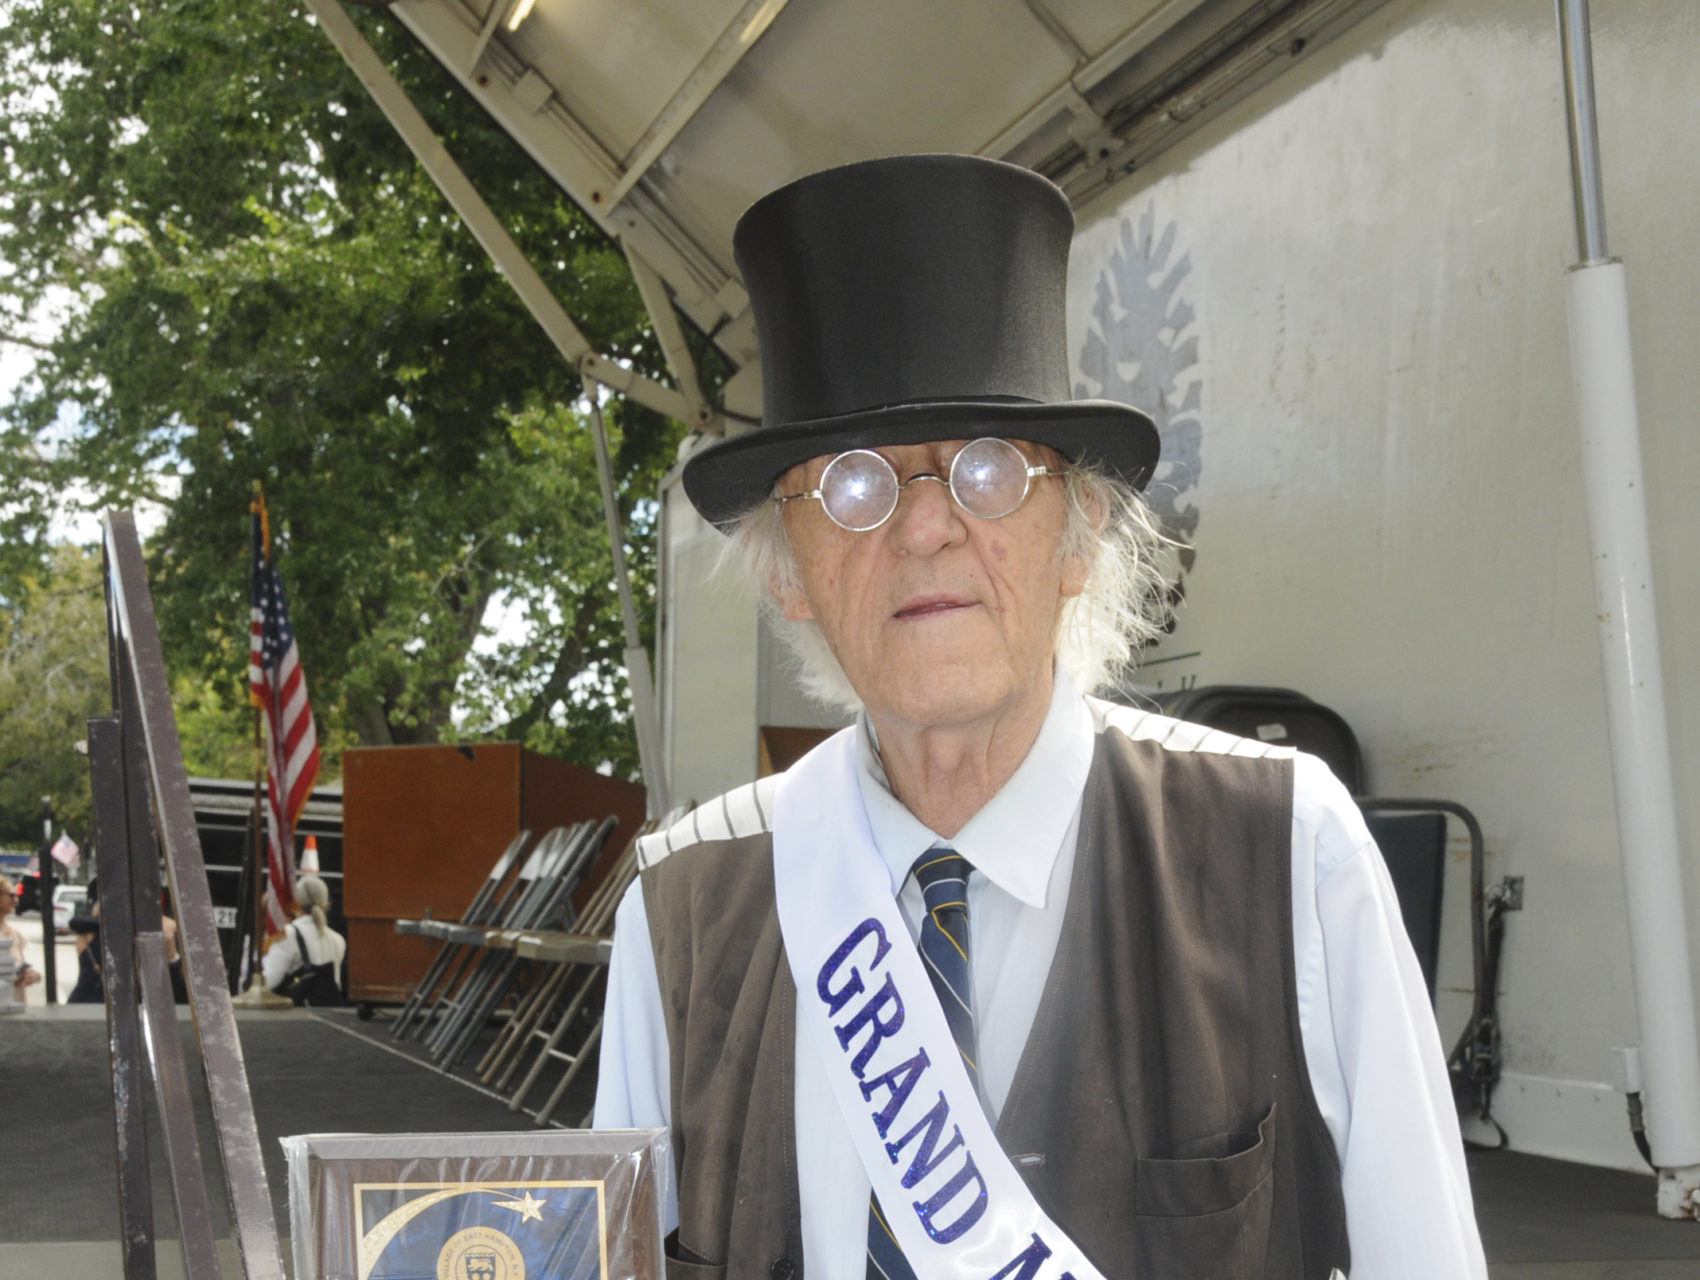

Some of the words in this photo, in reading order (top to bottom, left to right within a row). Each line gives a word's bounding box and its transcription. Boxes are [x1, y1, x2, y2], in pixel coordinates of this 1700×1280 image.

[815, 916, 990, 1246] GRAND
[443, 1248, 455, 1278] VILLAGE
[463, 1232, 482, 1242] EAST
